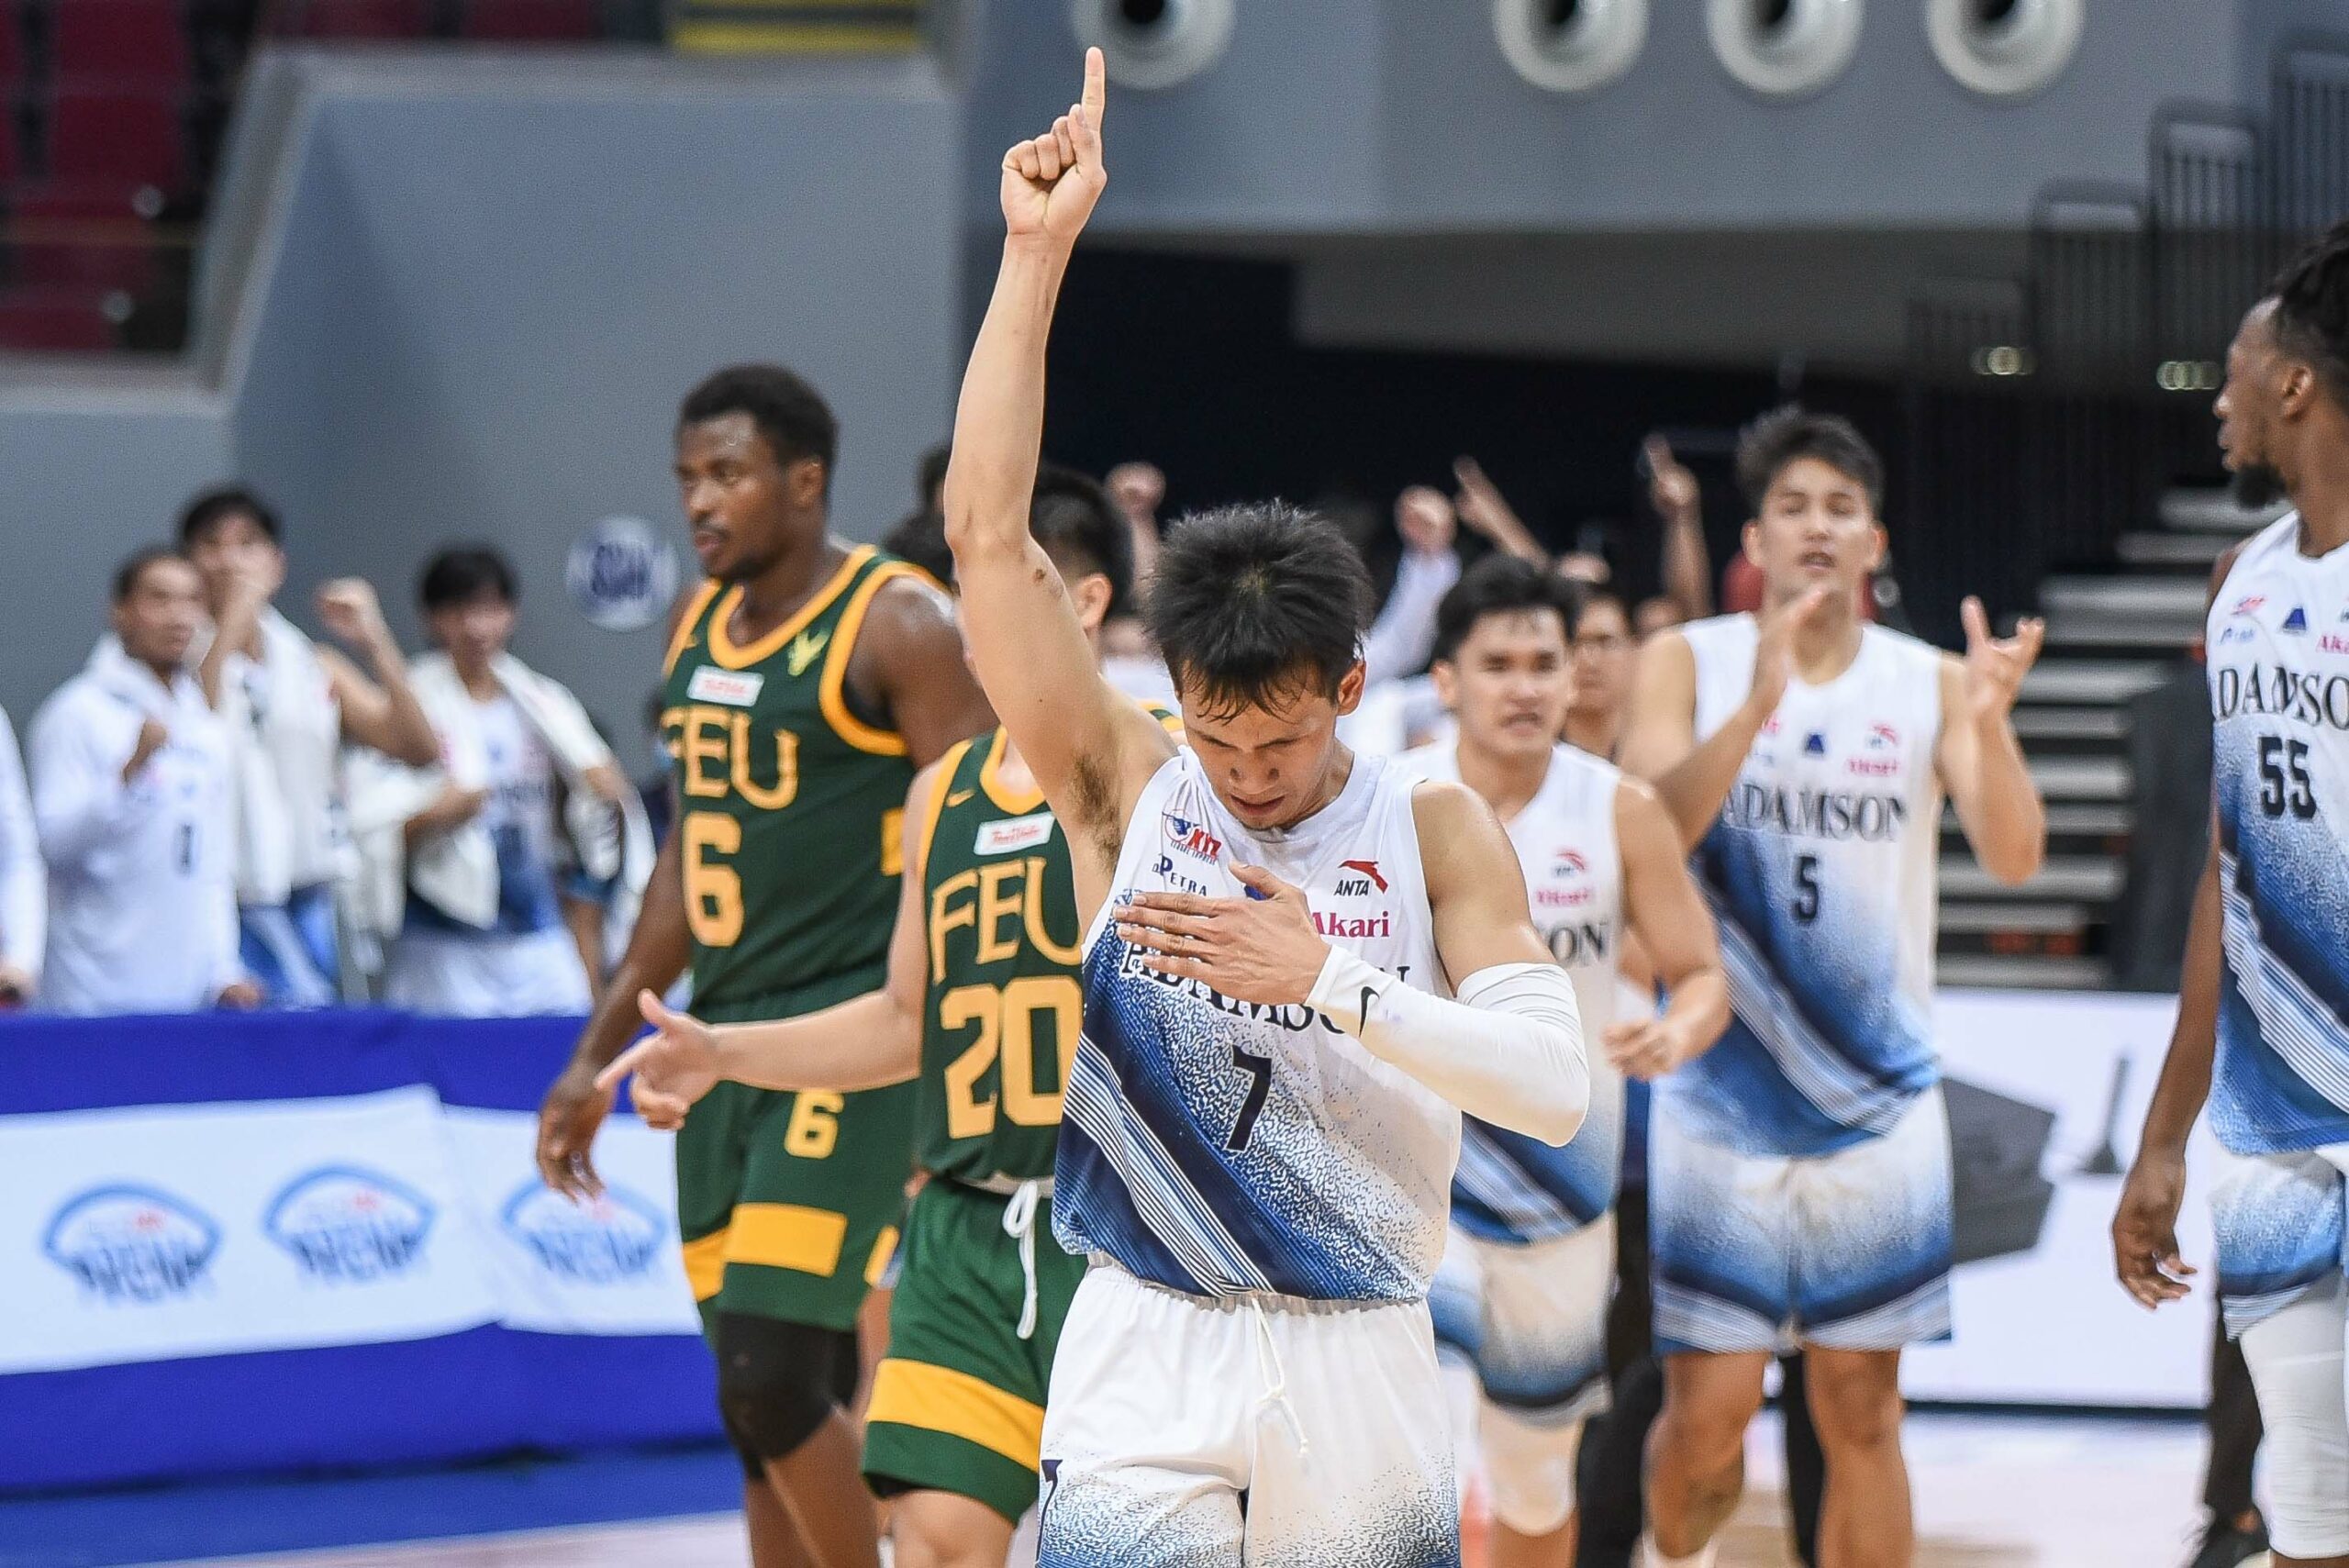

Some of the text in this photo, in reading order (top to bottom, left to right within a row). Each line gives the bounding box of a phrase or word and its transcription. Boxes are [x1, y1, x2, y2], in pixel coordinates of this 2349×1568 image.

[2256, 735, 2318, 820] 55
[682, 811, 745, 948] 6
[930, 855, 1083, 986] FEU
[1333, 879, 1370, 896] ANTA
[1792, 852, 1820, 924] 5
[1312, 910, 1390, 938] Akari
[940, 974, 1083, 1140] 20
[1224, 1044, 1273, 1152] 7
[783, 1087, 846, 1160] 6
